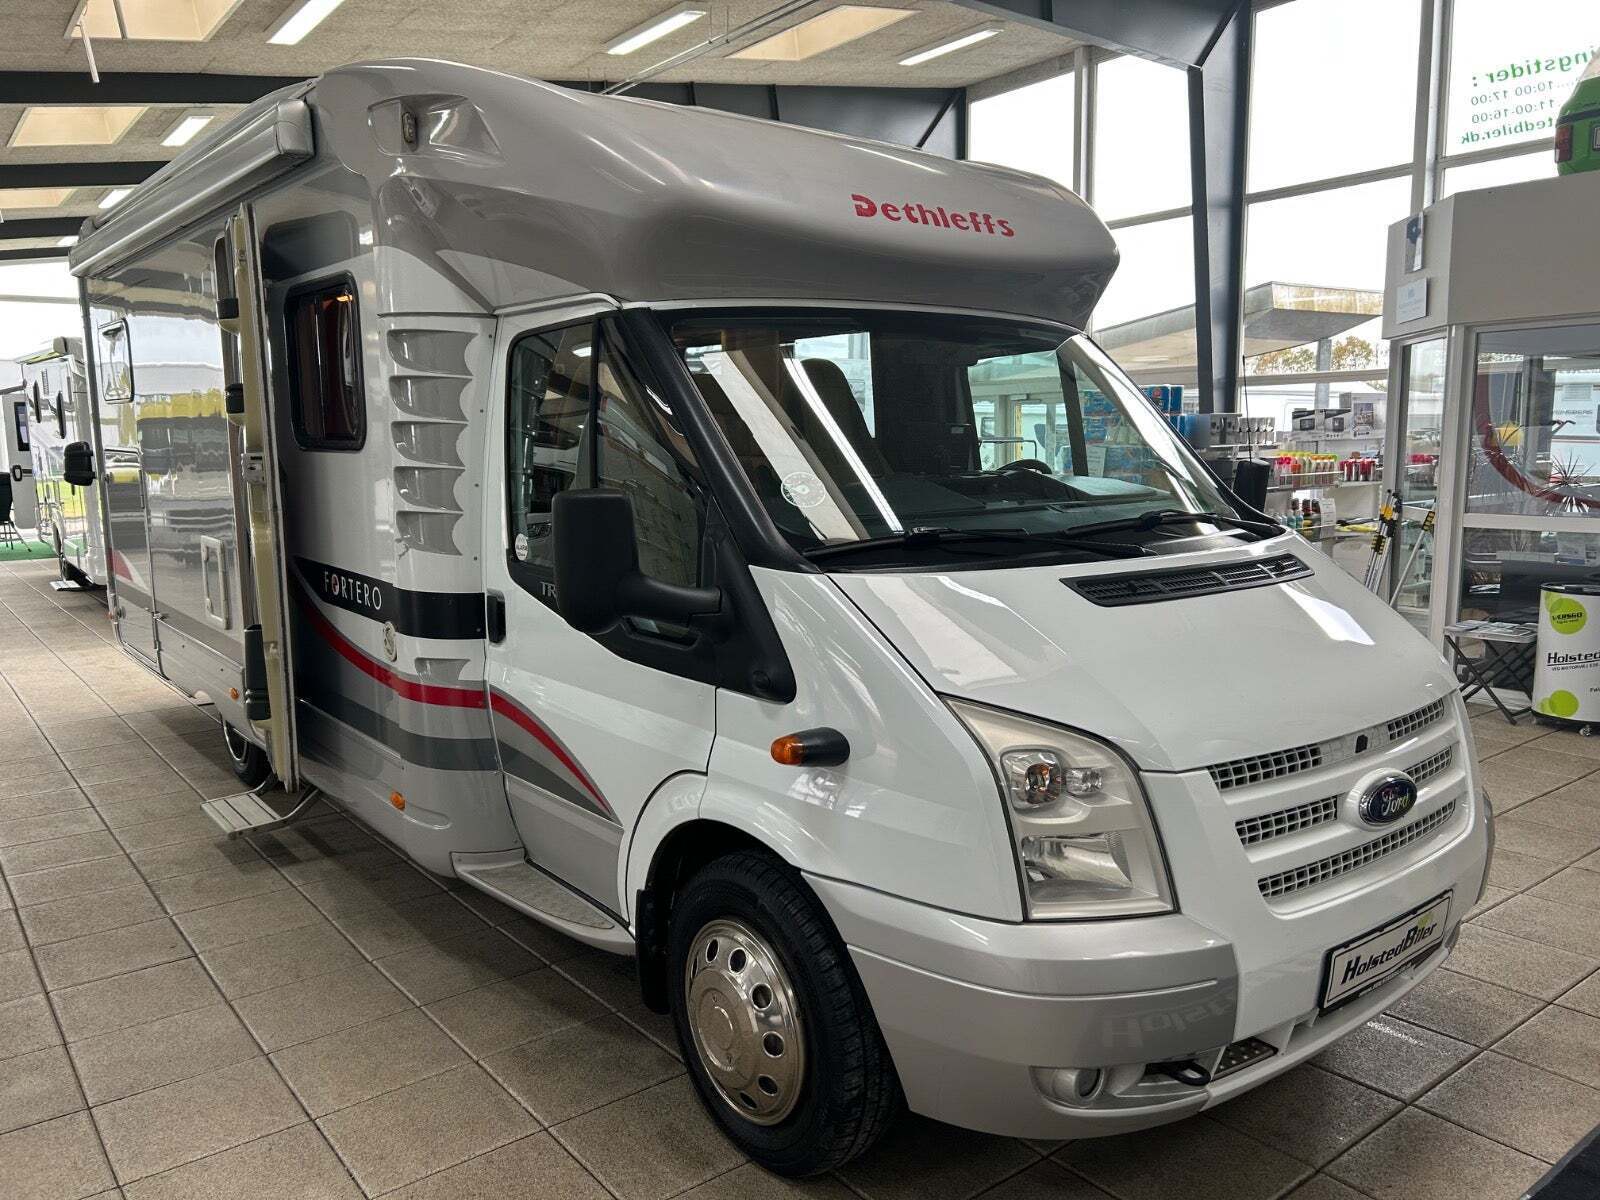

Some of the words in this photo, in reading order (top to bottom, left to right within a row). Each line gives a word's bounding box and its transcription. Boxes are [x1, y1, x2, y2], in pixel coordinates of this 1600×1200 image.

[851, 194, 1015, 237] Dethleffs
[324, 570, 382, 610] FORTERO
[1381, 787, 1410, 816] Ford
[1340, 922, 1438, 985] HolstedBiler
